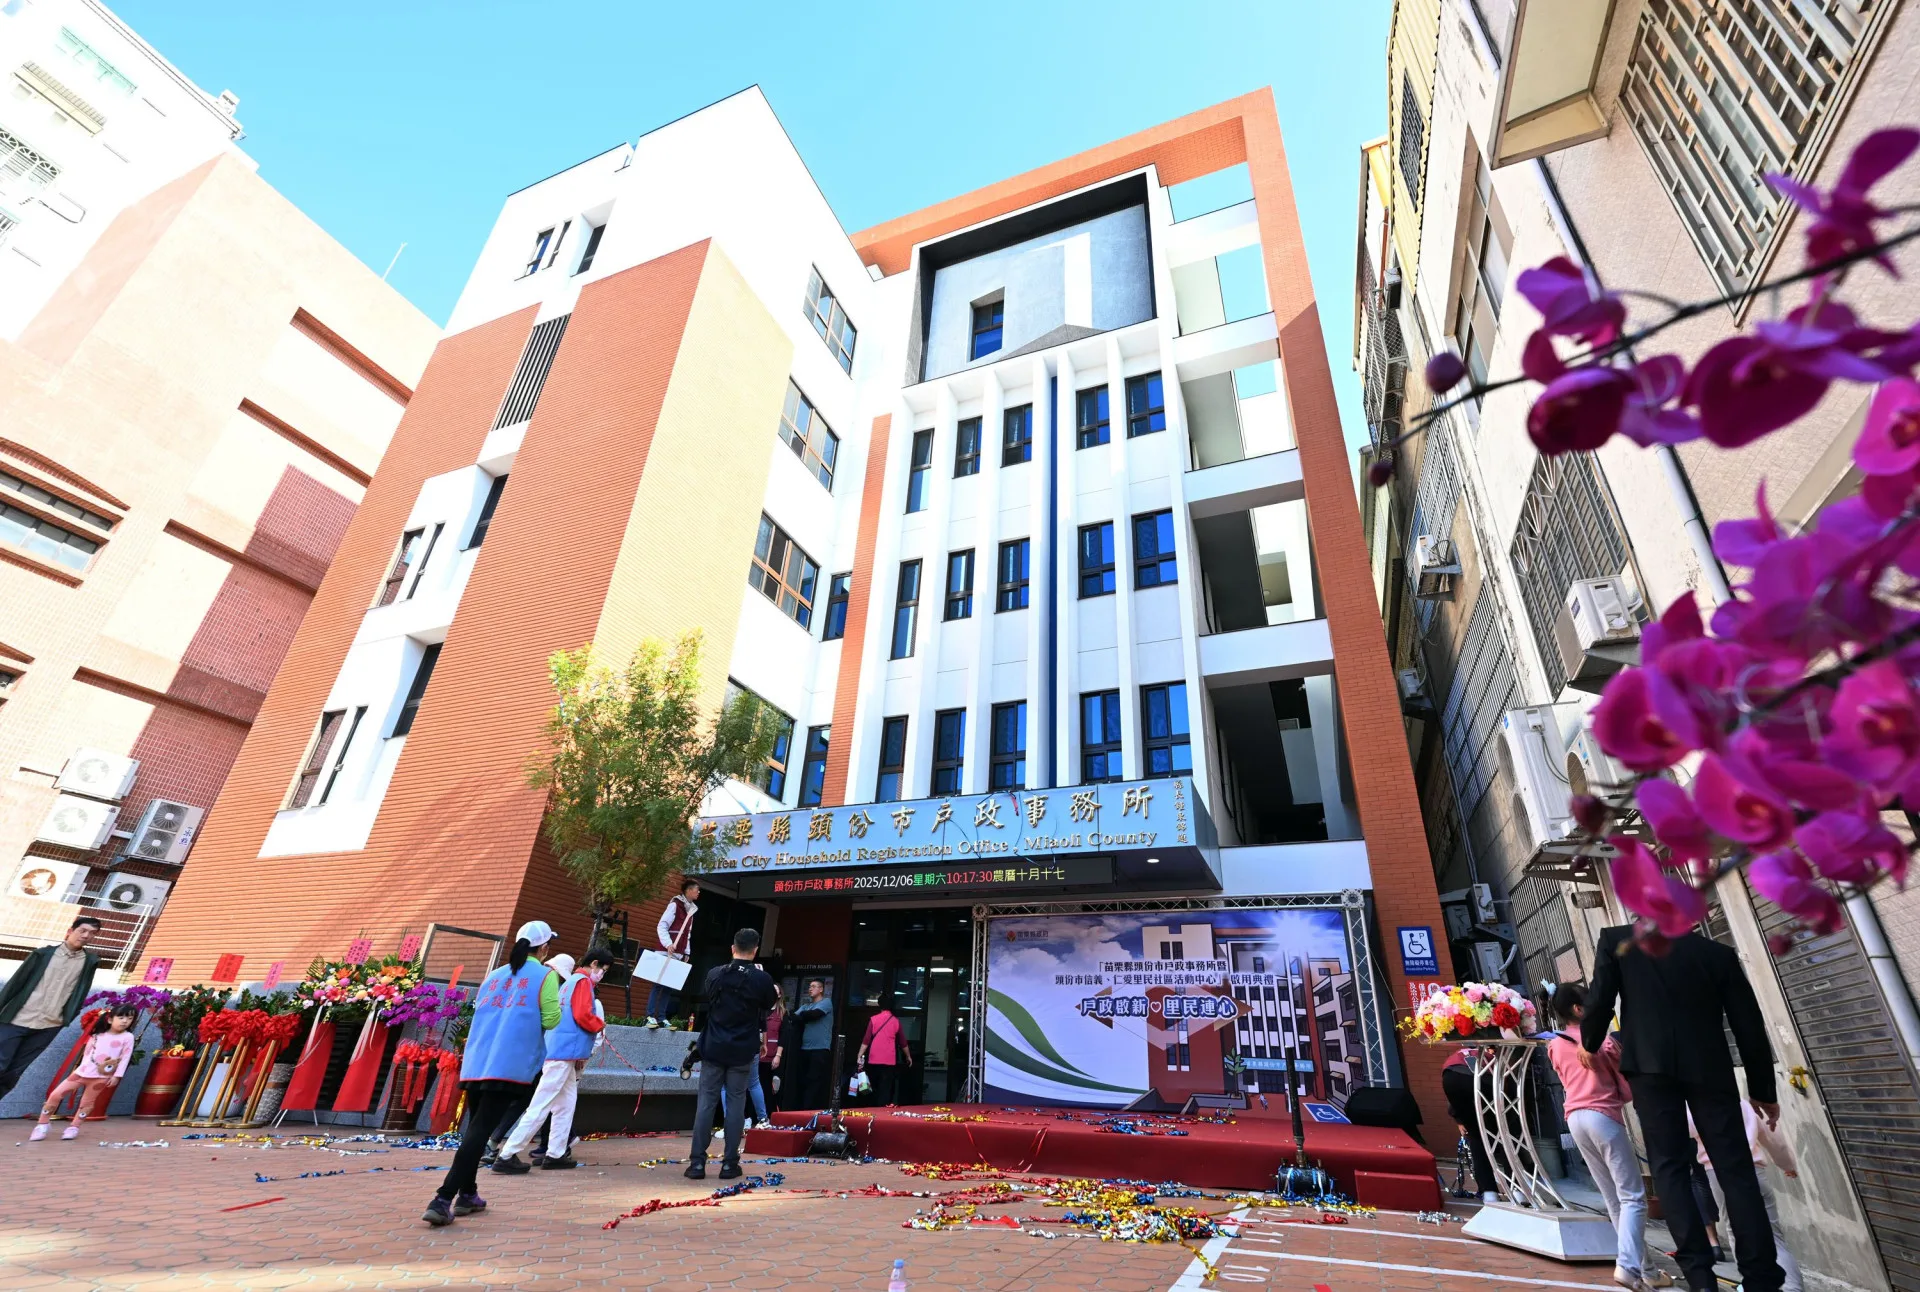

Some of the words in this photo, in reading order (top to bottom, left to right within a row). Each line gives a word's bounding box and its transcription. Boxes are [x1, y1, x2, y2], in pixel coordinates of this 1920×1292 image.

[742, 854, 771, 869] City
[775, 849, 851, 866] Household
[857, 843, 953, 862] Registration
[1024, 834, 1082, 850] Miaoli
[1087, 831, 1158, 846] County
